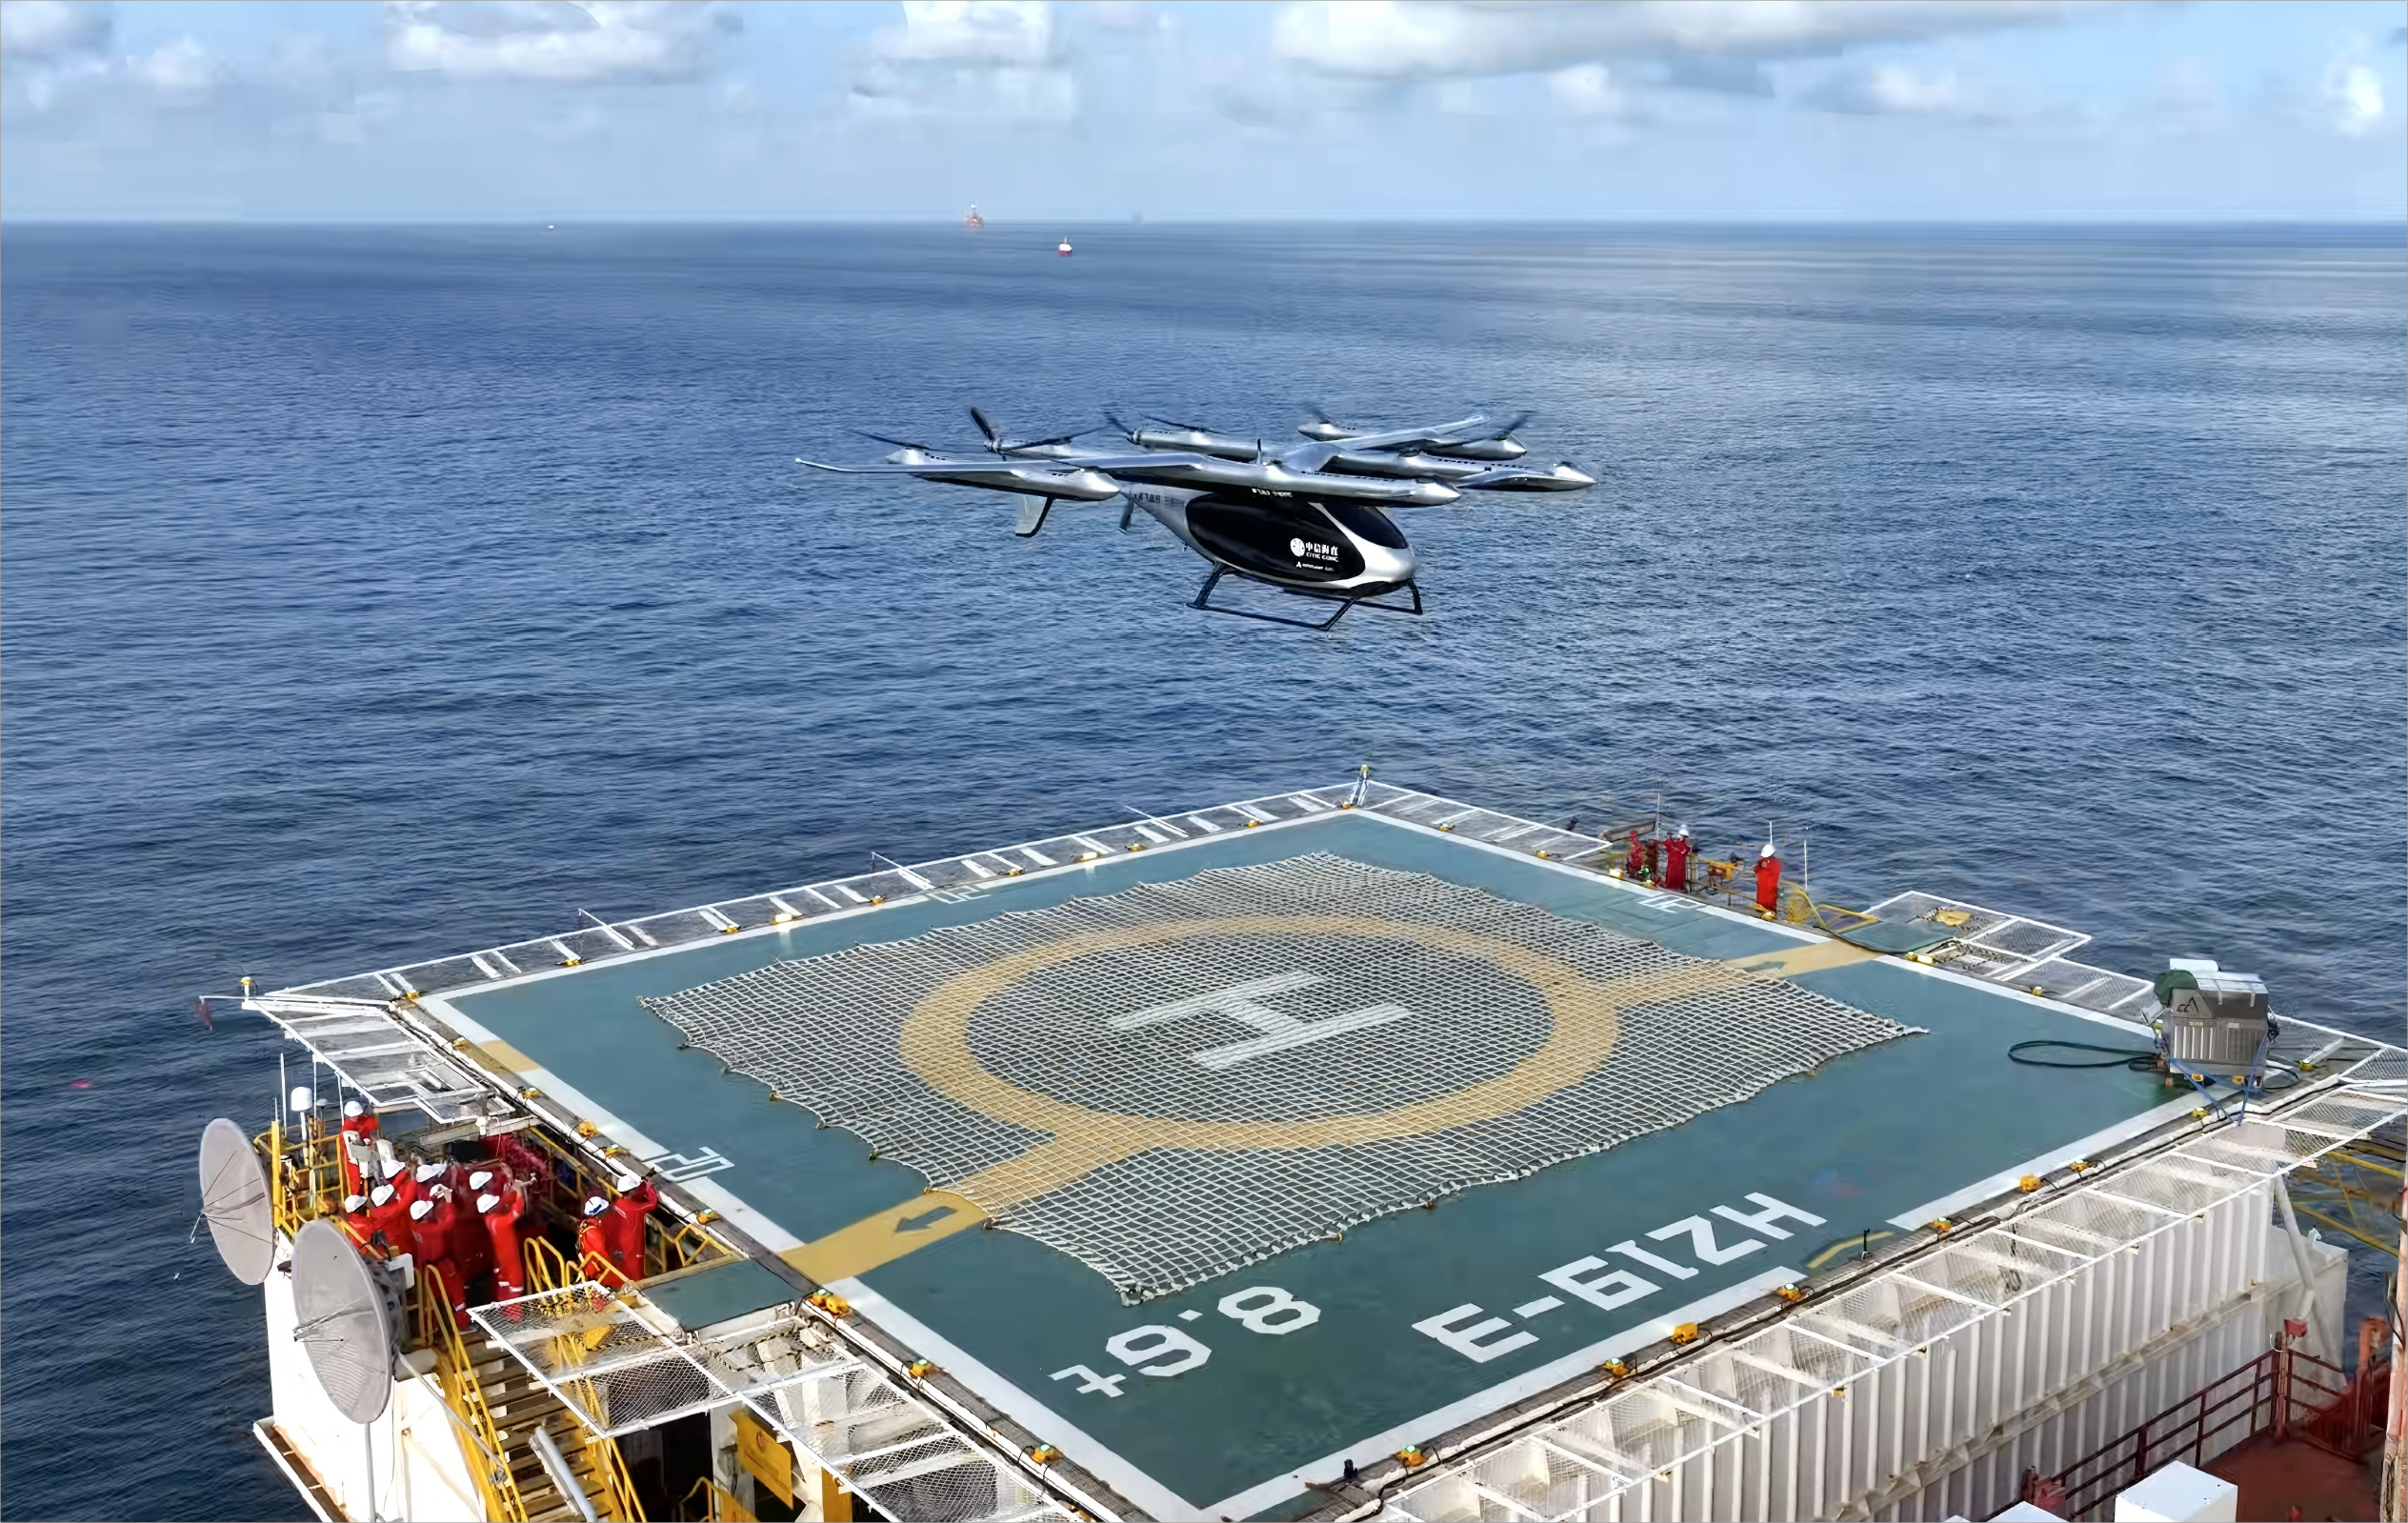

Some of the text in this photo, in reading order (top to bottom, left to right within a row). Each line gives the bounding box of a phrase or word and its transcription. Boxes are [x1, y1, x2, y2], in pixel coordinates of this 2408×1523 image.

[1107, 968, 1415, 1071] H
[1411, 1192, 1828, 1364] HZ19-3
[1049, 1286, 1321, 1398] 8.6t
